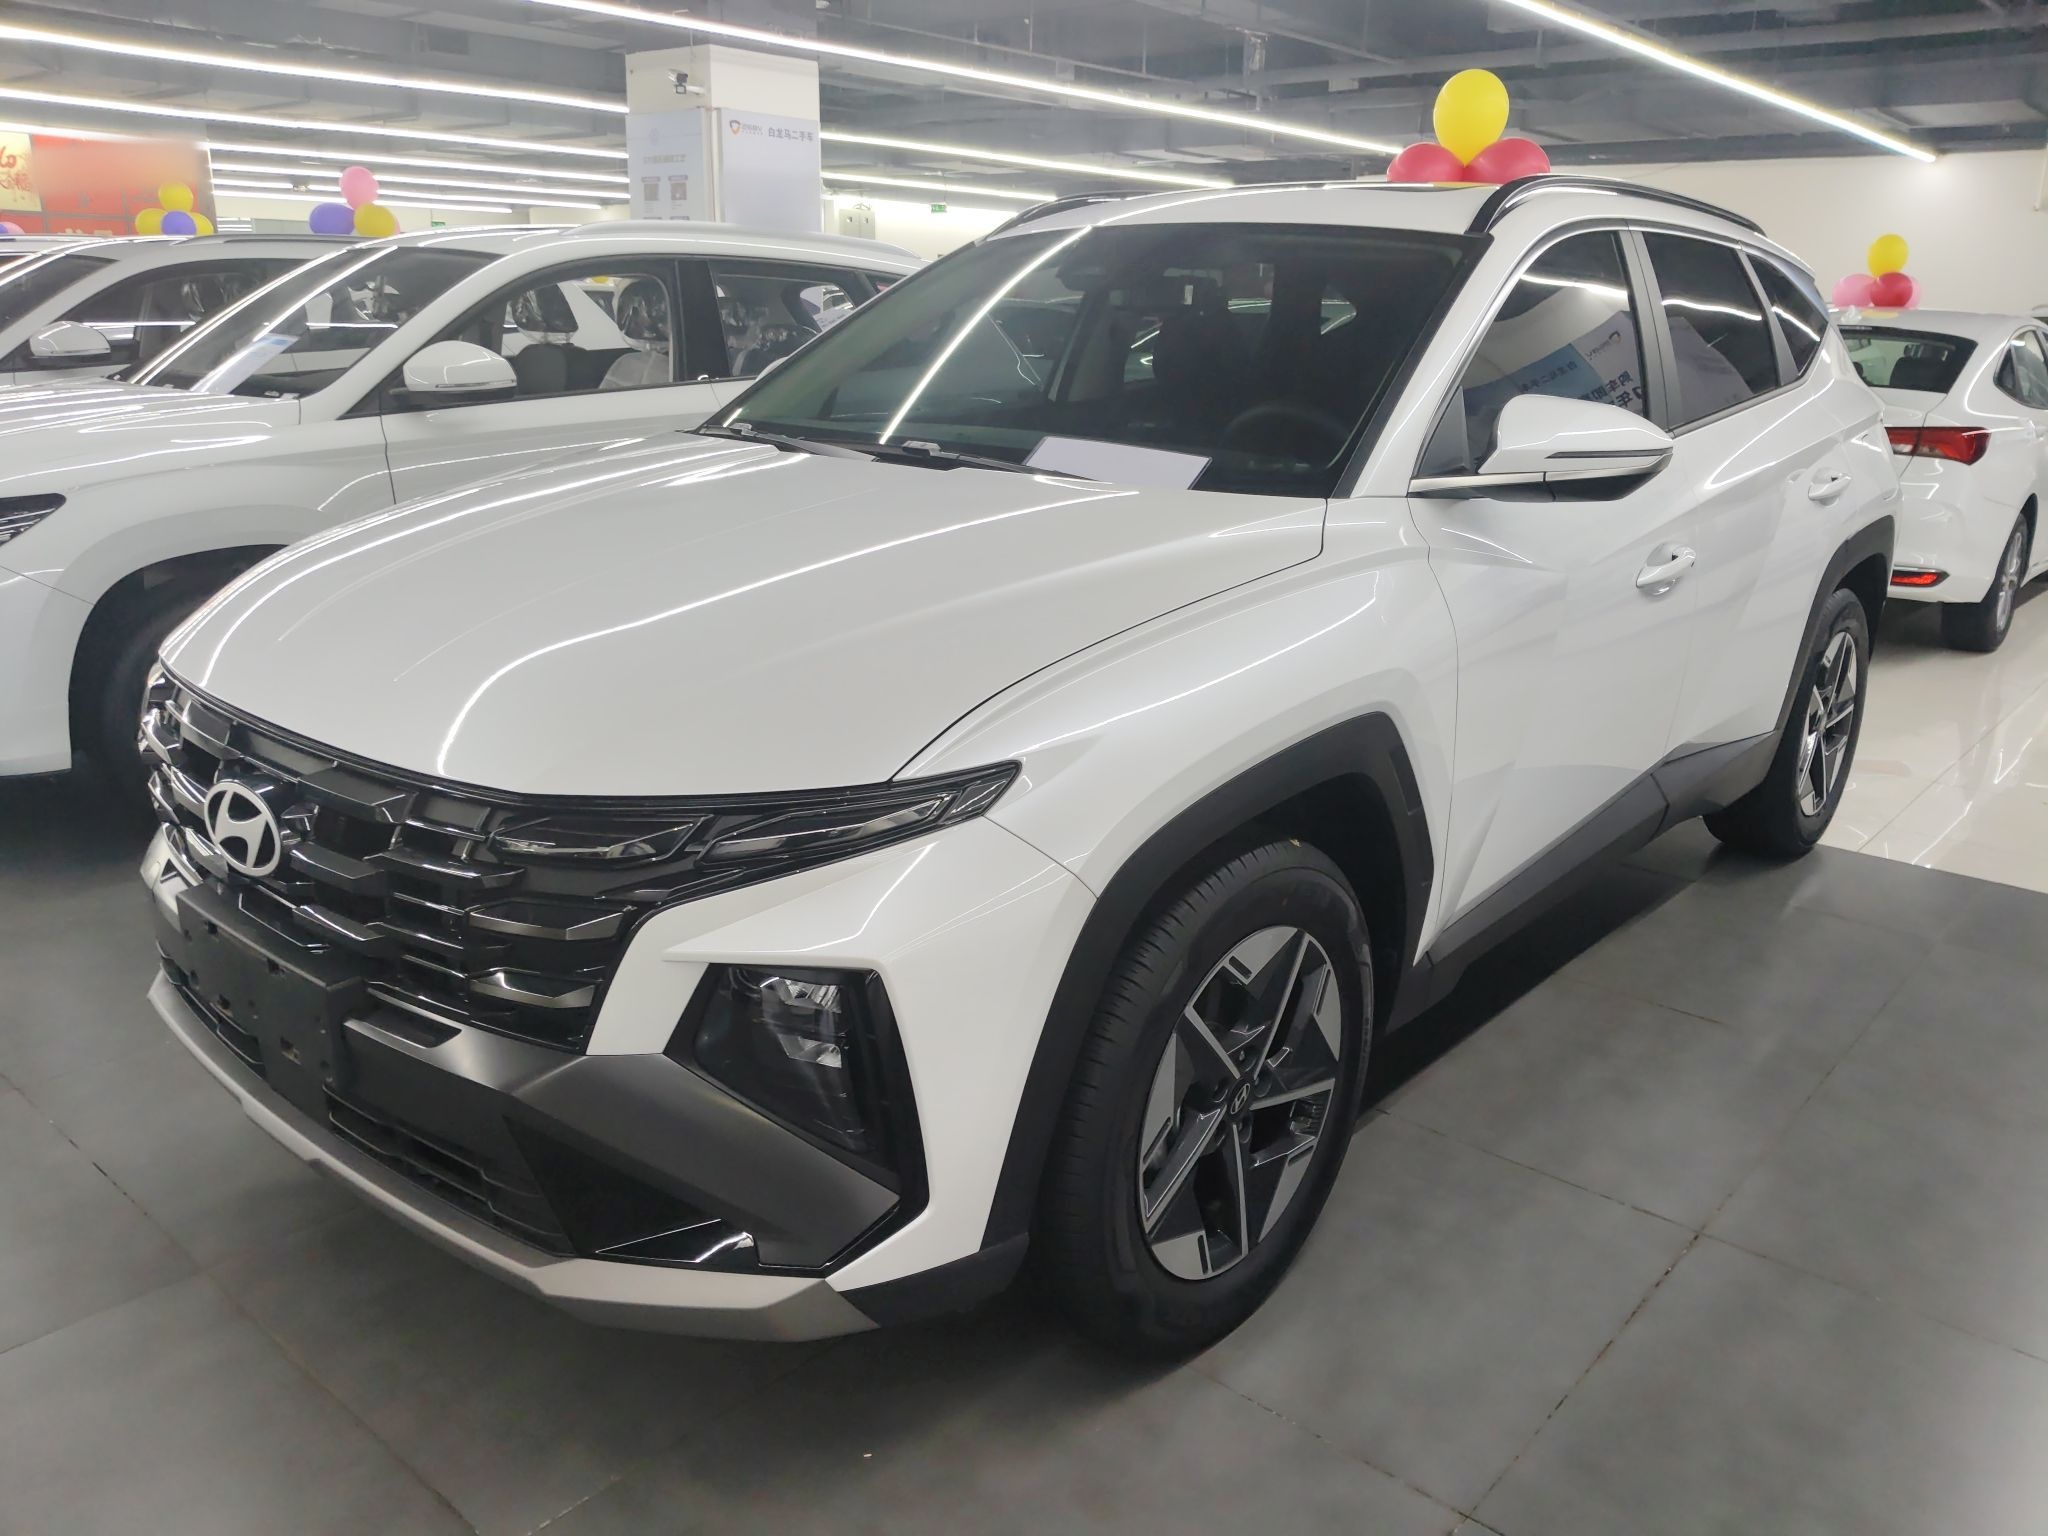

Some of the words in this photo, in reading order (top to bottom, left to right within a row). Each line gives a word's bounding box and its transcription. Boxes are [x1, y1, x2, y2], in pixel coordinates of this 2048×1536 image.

[768, 127, 813, 142] 白龙马二手车
